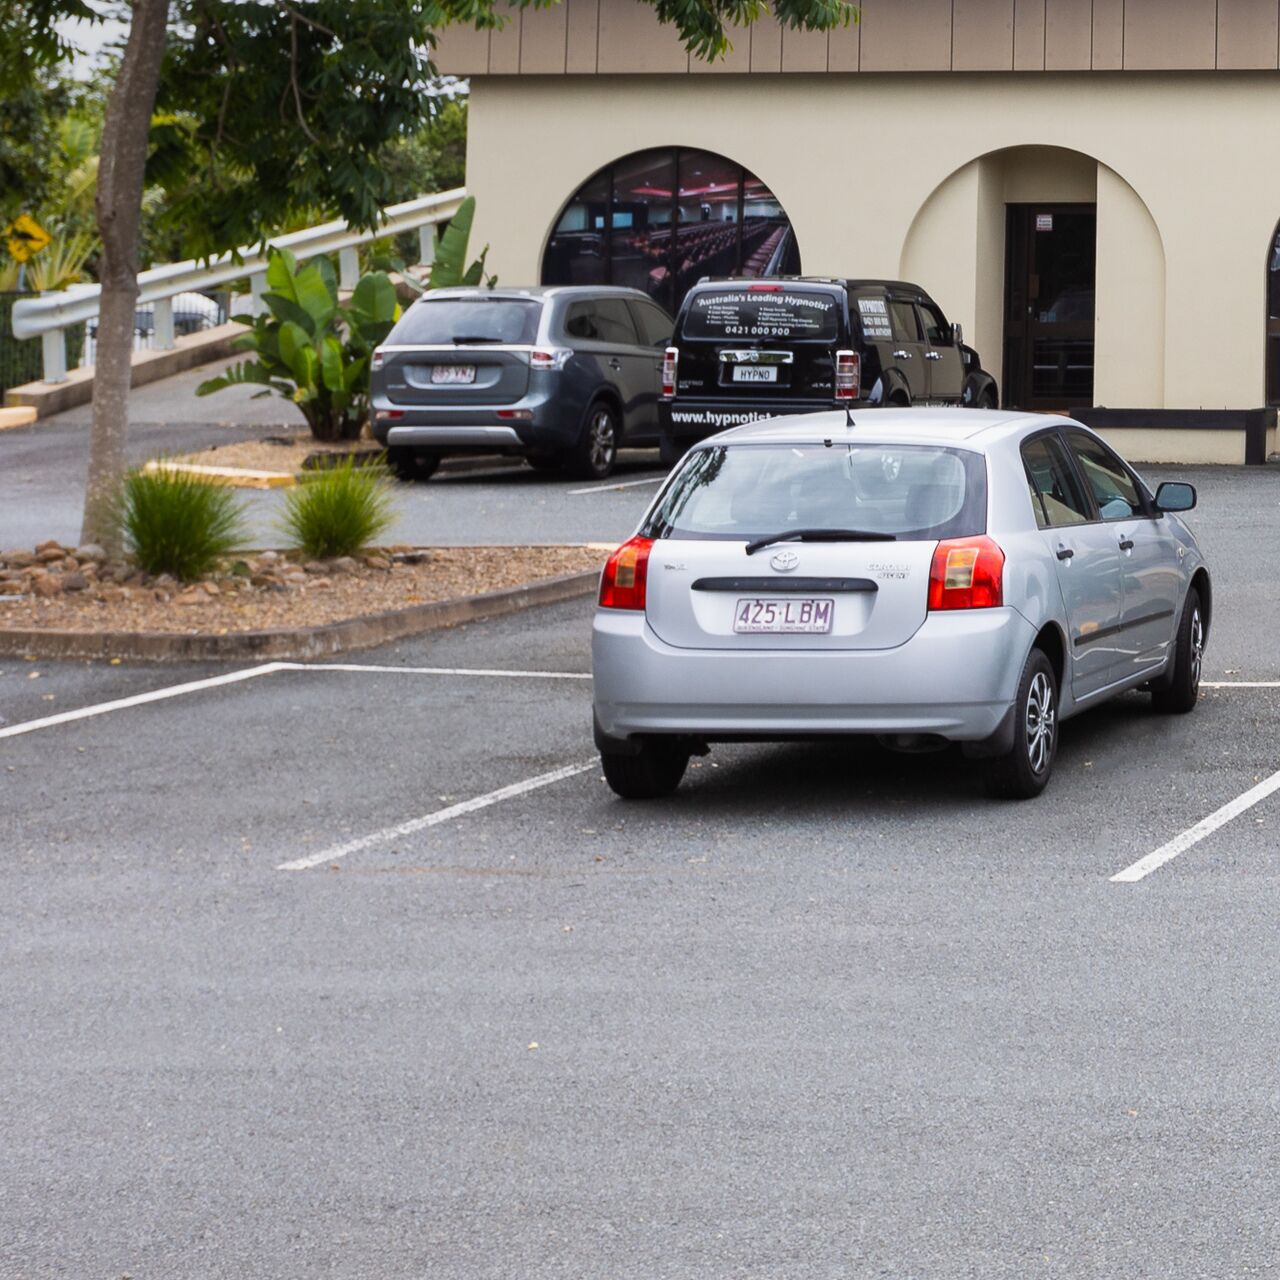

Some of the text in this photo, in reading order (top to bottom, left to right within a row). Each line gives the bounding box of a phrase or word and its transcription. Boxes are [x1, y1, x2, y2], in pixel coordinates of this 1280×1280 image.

[747, 294, 783, 304] Leading
[725, 326, 790, 335] 0421 000 900
[740, 370, 770, 380] HYPNO
[671, 411, 785, 427] www.hypnotist
